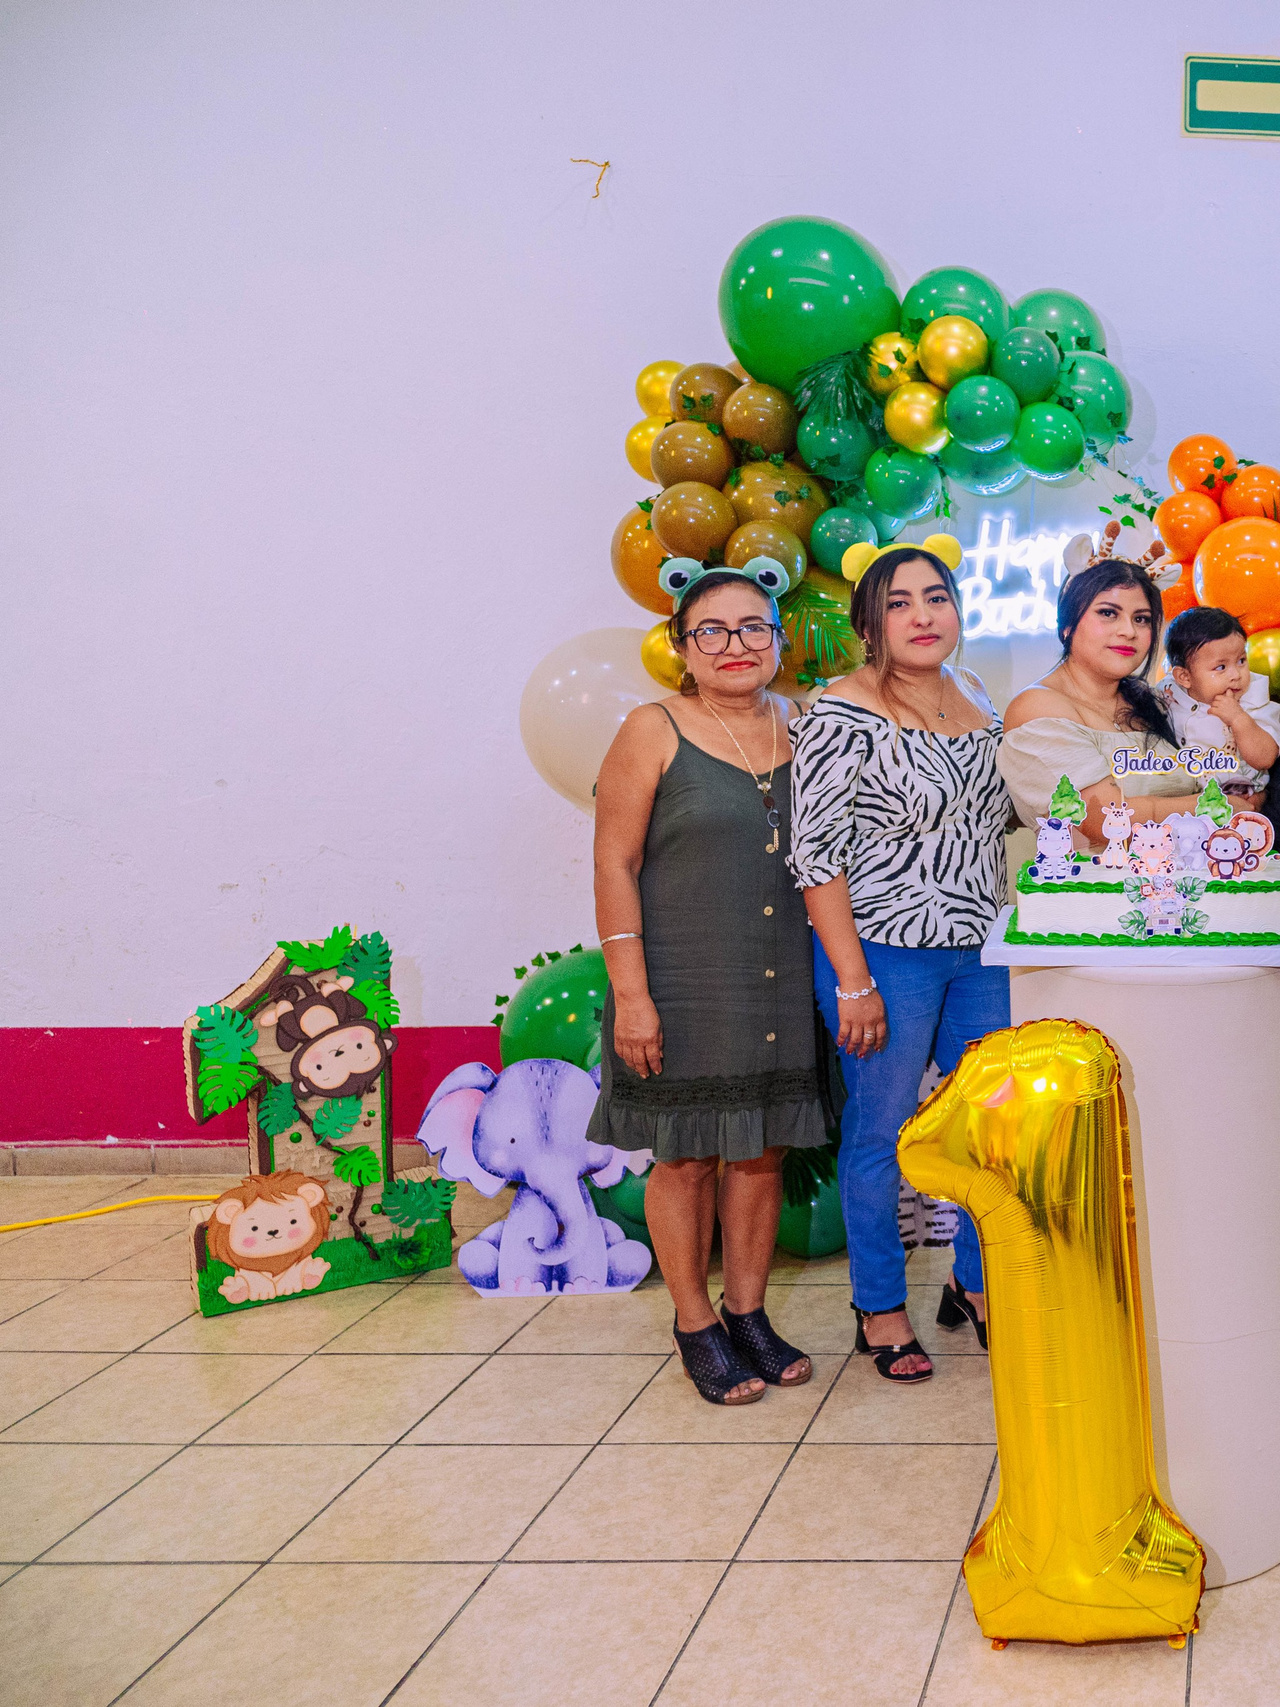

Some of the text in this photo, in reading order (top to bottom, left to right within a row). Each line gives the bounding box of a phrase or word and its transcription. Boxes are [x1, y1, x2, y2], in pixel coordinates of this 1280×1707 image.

[958, 576, 1058, 637] Birth
[1112, 746, 1237, 775] Tadeo Edén
[899, 1018, 1206, 1651] 1
